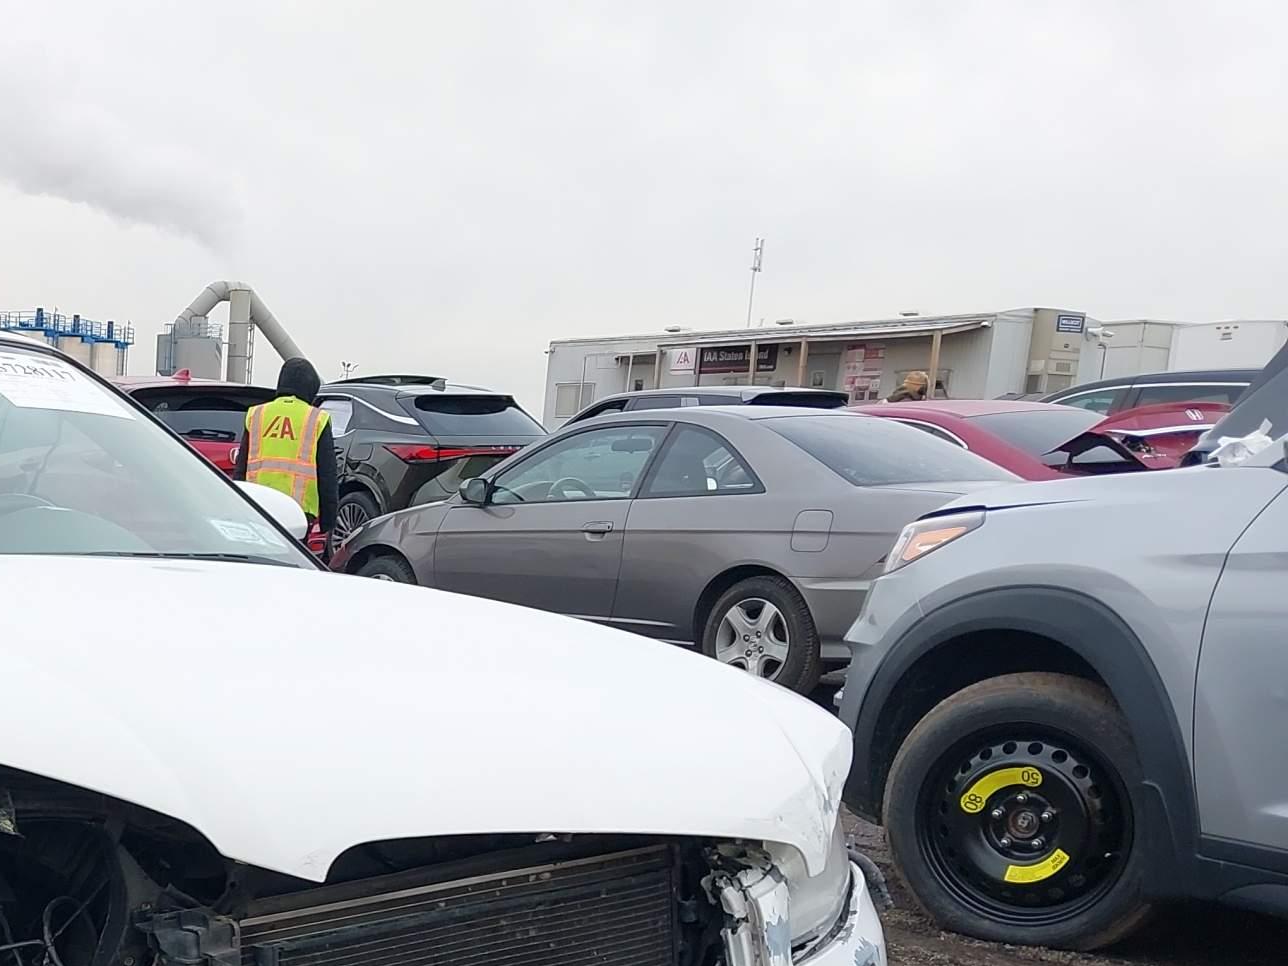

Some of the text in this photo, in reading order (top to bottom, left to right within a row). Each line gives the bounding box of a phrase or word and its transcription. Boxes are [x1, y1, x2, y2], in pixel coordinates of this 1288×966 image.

[704, 349, 769, 362] IAA Staten Isnd
[1021, 770, 1040, 785] 50
[964, 793, 983, 811] 80
